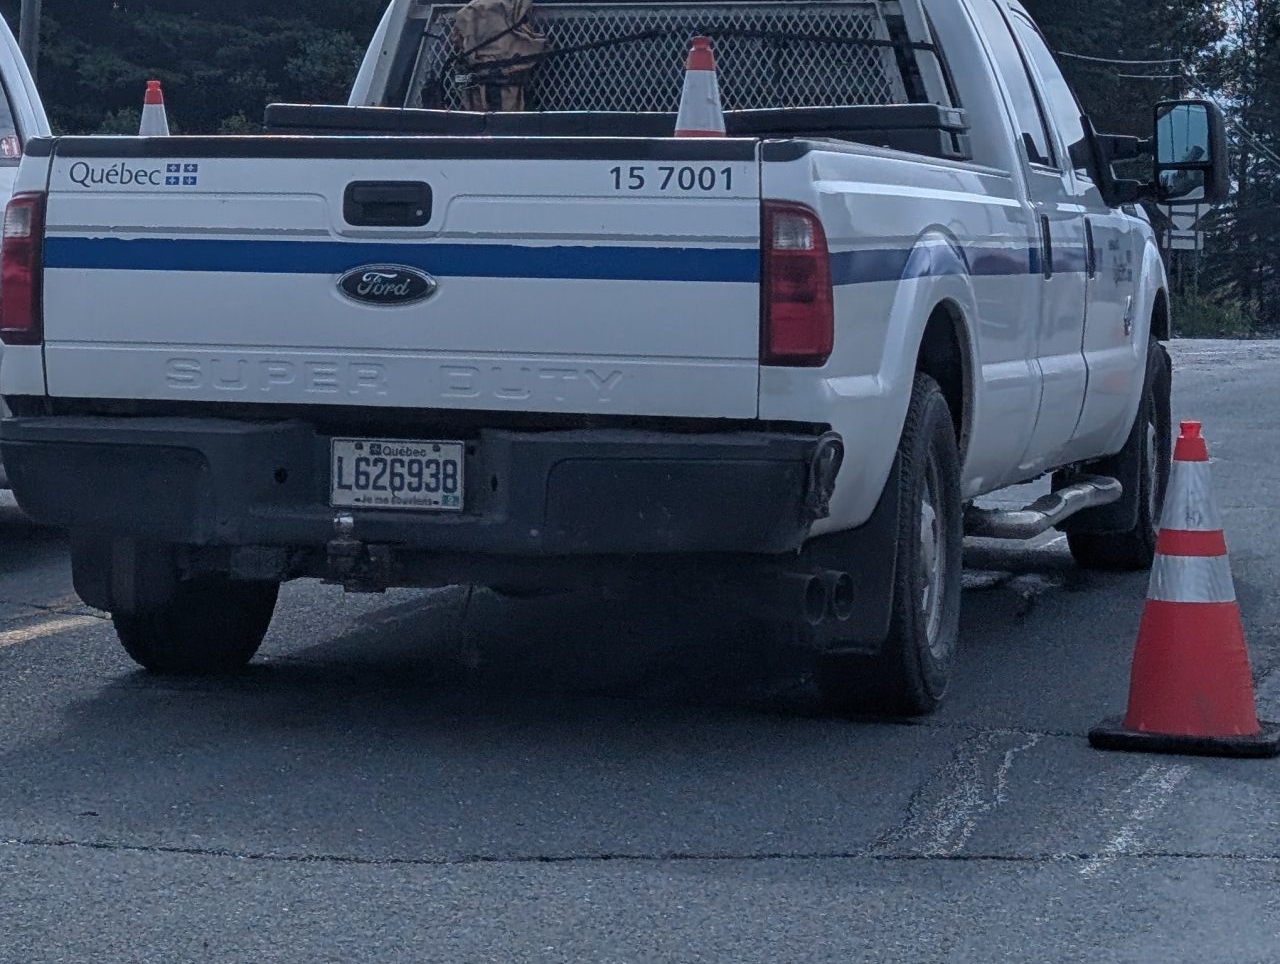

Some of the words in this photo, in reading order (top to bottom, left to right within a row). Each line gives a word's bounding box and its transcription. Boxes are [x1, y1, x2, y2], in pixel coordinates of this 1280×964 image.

[69, 161, 162, 188] Québec
[609, 166, 645, 190] 15
[658, 166, 732, 191] 7001
[357, 271, 411, 296] Ford
[164, 356, 389, 396] SUPER
[439, 363, 624, 403] DUTY
[382, 445, 427, 457] Québec
[336, 455, 459, 494] L626938
